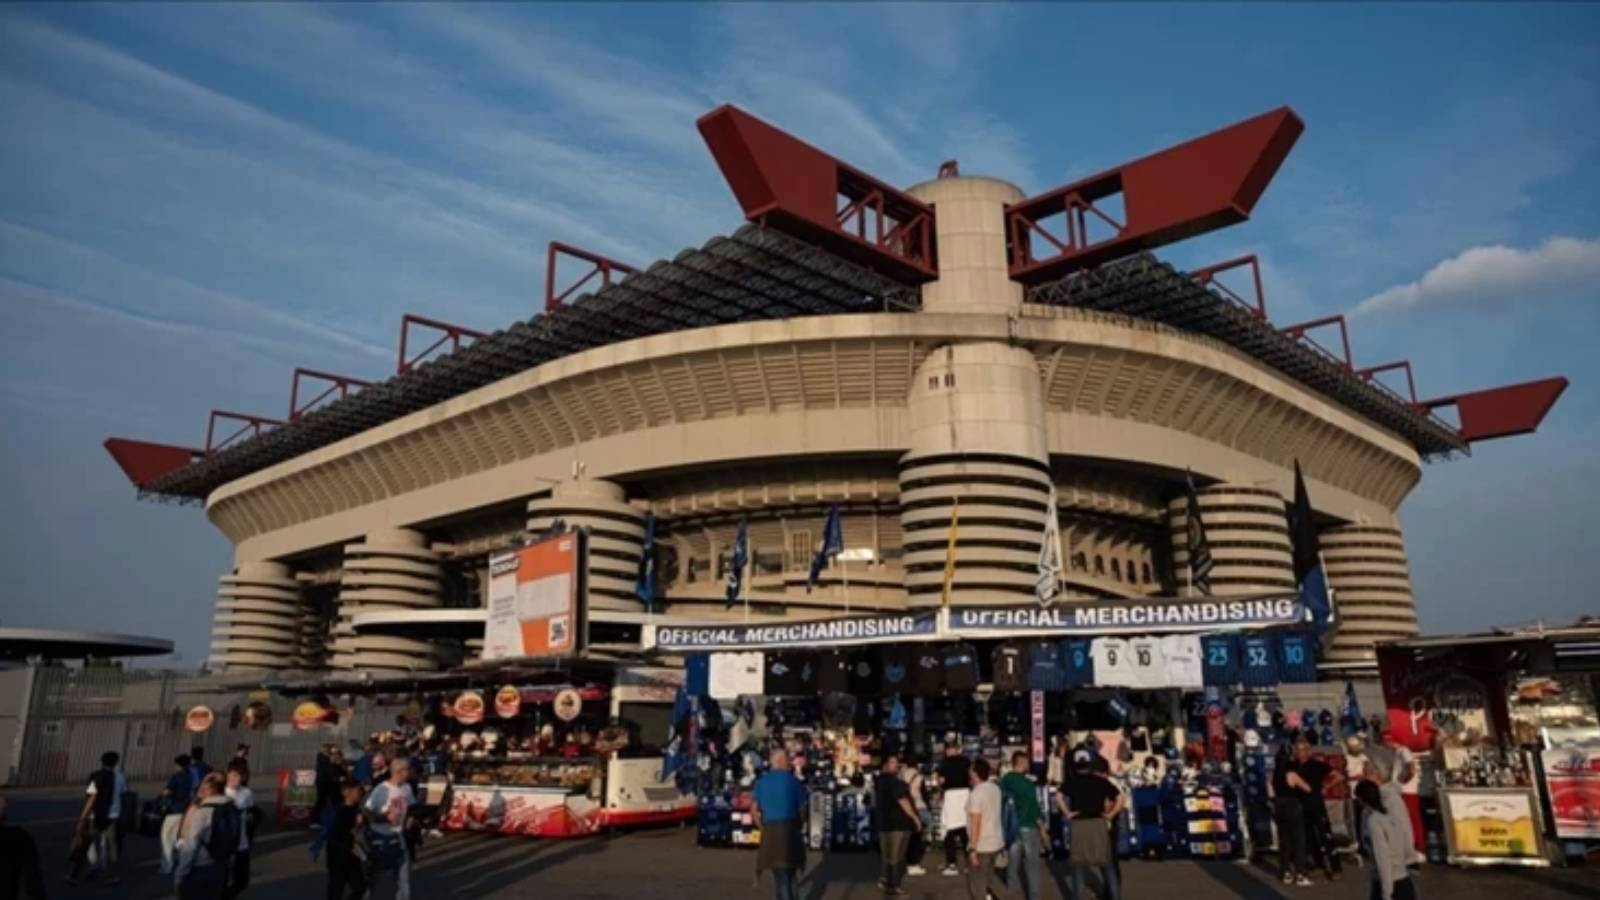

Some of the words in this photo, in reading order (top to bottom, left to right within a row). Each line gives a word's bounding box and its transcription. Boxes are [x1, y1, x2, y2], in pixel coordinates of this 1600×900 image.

[963, 608, 1067, 627] OFFICIAL
[1075, 600, 1294, 625] MERCHANDISING
[658, 628, 739, 645] OFFICIAL
[745, 616, 915, 642] MERCHANDISING
[1073, 650, 1084, 668] 9
[1107, 649, 1118, 667] 9
[1136, 649, 1151, 667] 10
[1208, 646, 1228, 666] 23
[1247, 646, 1268, 666] 32
[1284, 645, 1304, 664] 10
[1007, 656, 1014, 675] 1
